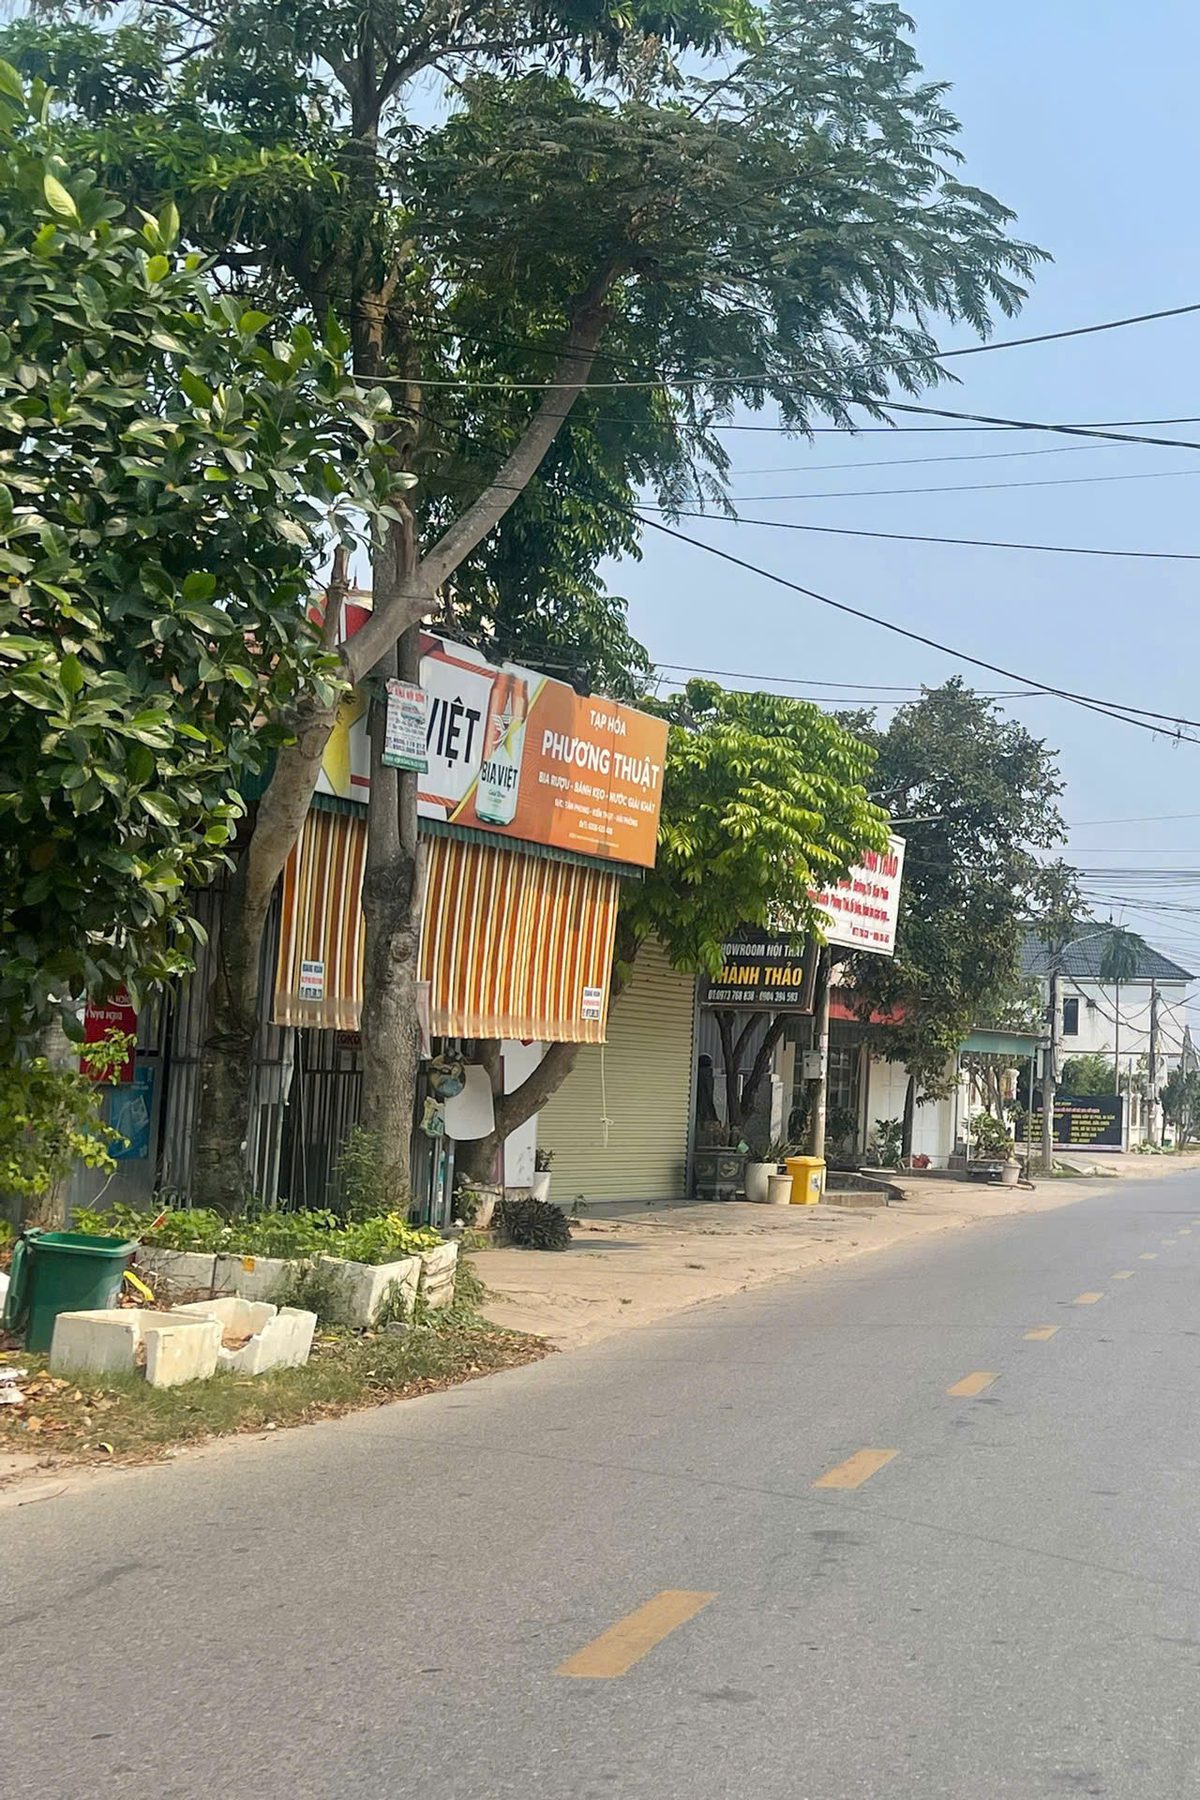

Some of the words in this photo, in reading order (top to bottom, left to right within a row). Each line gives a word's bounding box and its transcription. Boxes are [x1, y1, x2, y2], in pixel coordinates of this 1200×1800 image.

[589, 710, 607, 731] TẠP
[607, 715, 626, 736] HÓA
[541, 730, 611, 775] PHƯƠNG
[613, 752, 660, 793] THUẬT
[481, 761, 497, 785] BIA
[497, 765, 518, 791] VIỆT
[720, 943, 764, 957] HOWROOM
[766, 942, 782, 959] NỘI
[711, 962, 760, 985] HÀNH
[764, 961, 803, 986] THẢO
